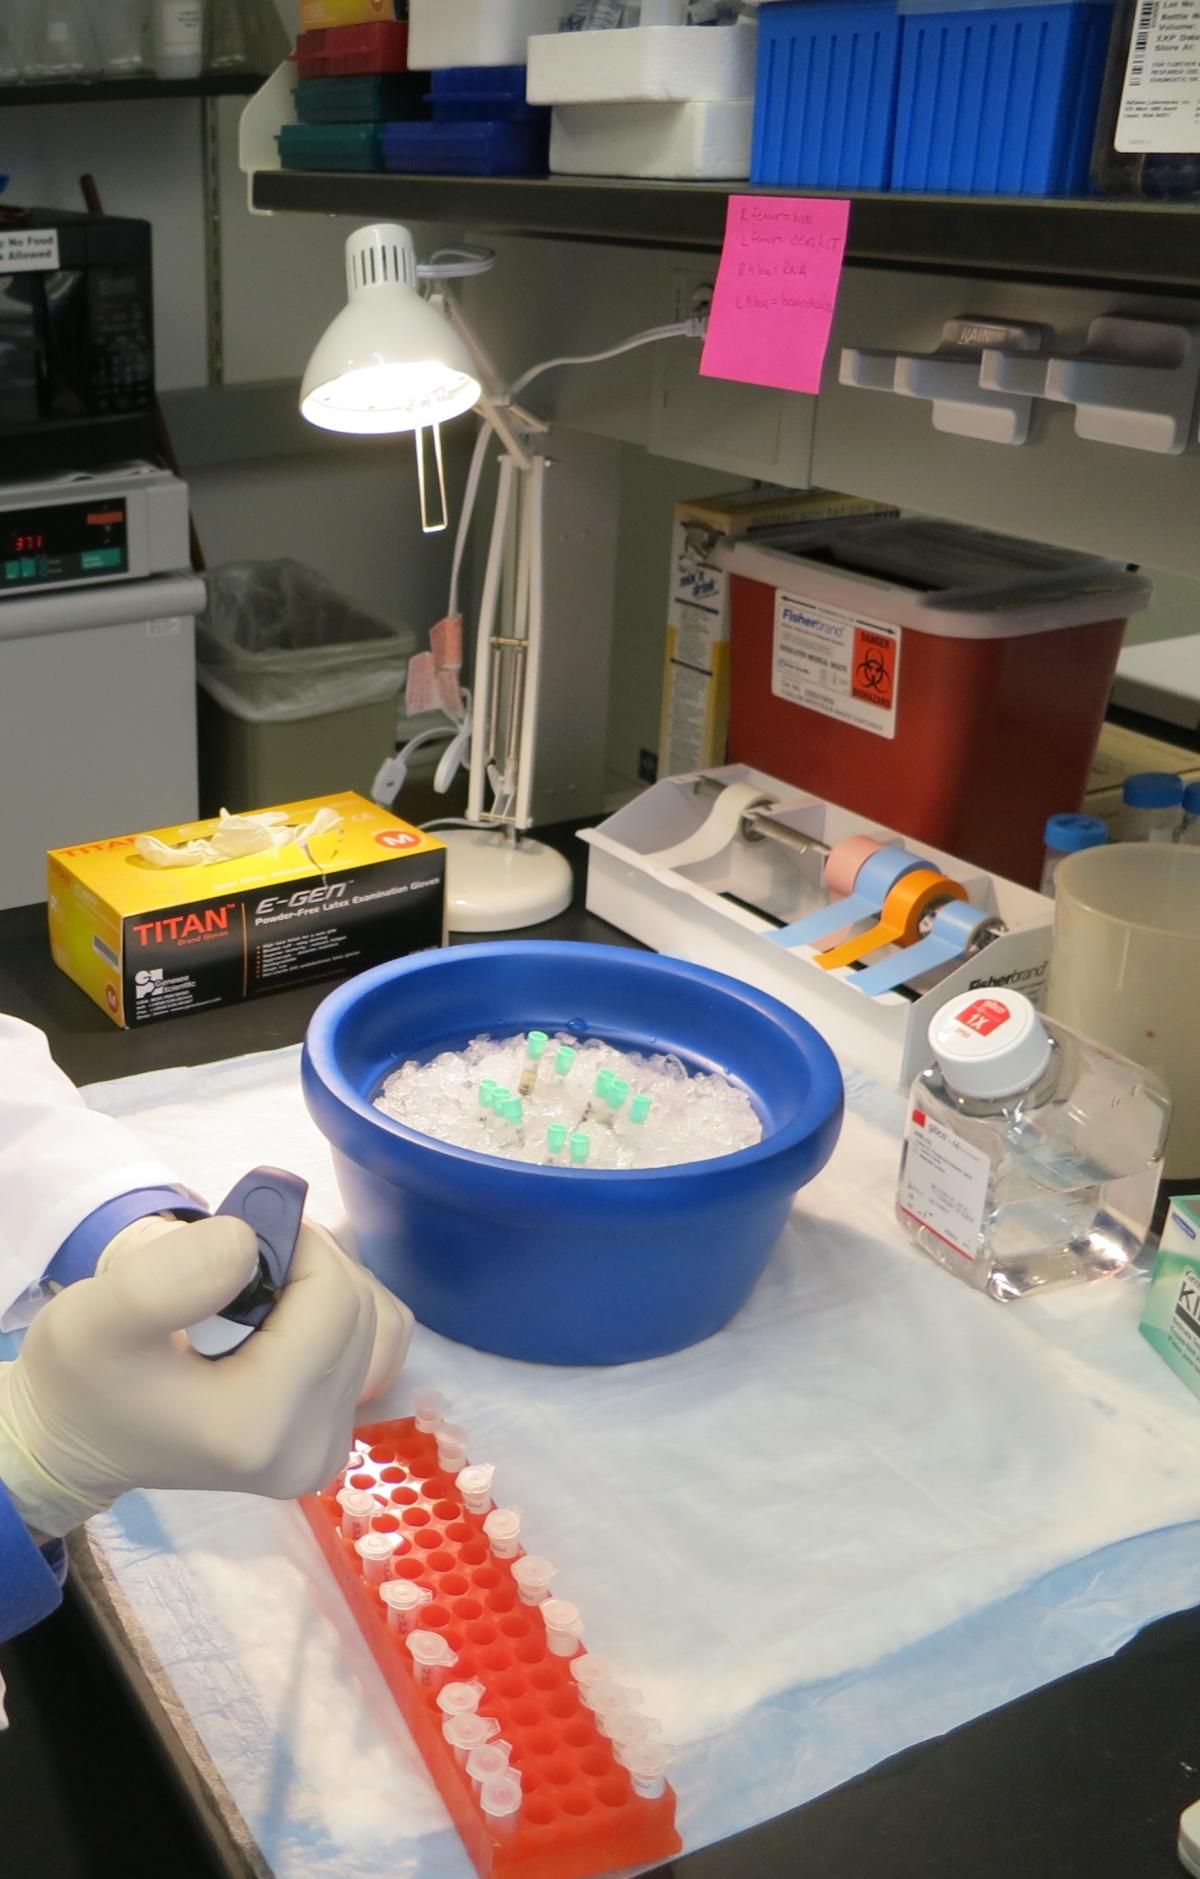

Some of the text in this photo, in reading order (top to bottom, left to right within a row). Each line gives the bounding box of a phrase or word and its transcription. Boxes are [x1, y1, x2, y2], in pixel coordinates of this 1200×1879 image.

[8, 237, 24, 247] No
[27, 236, 54, 246] Food
[8, 249, 52, 260] Allowed
[860, 631, 890, 648] DANGER
[852, 687, 892, 708] BIOHAZARD
[383, 834, 415, 847] M
[255, 877, 440, 926] Powder-Free Latex Examination Gloves
[177, 931, 229, 946] Brand Gloves
[155, 975, 190, 988] Genesee
[163, 980, 197, 993] Scientific
[967, 1014, 990, 1029] 1X
